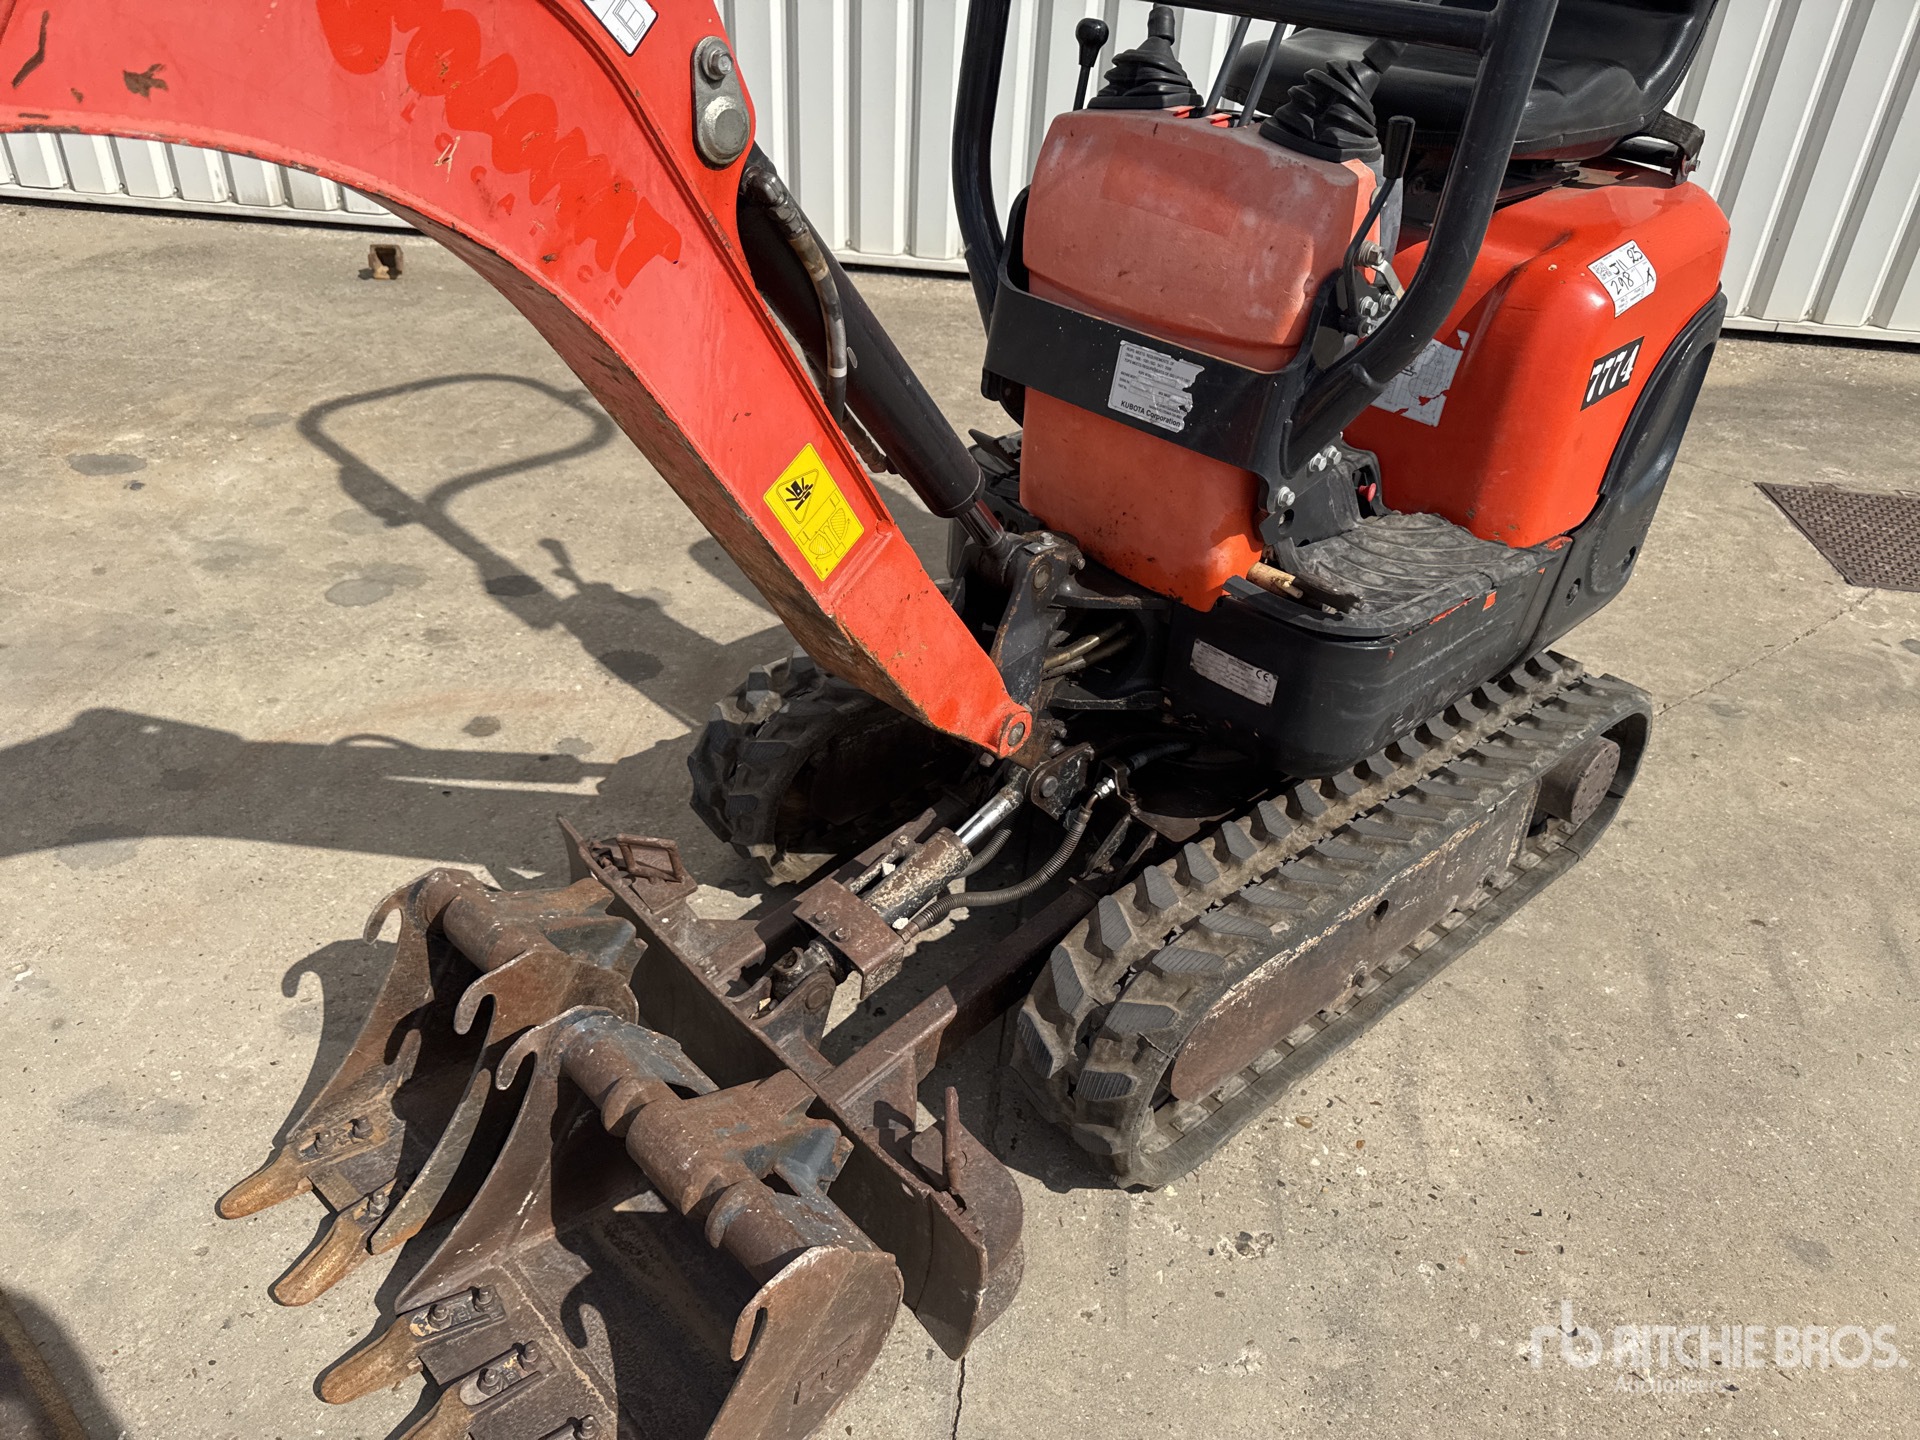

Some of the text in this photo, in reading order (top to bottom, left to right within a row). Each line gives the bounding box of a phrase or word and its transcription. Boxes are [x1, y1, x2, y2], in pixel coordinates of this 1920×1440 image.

[1586, 344, 1640, 403] 7774
[1120, 400, 1145, 415] KUBOTA
[1146, 409, 1181, 428] Corporation
